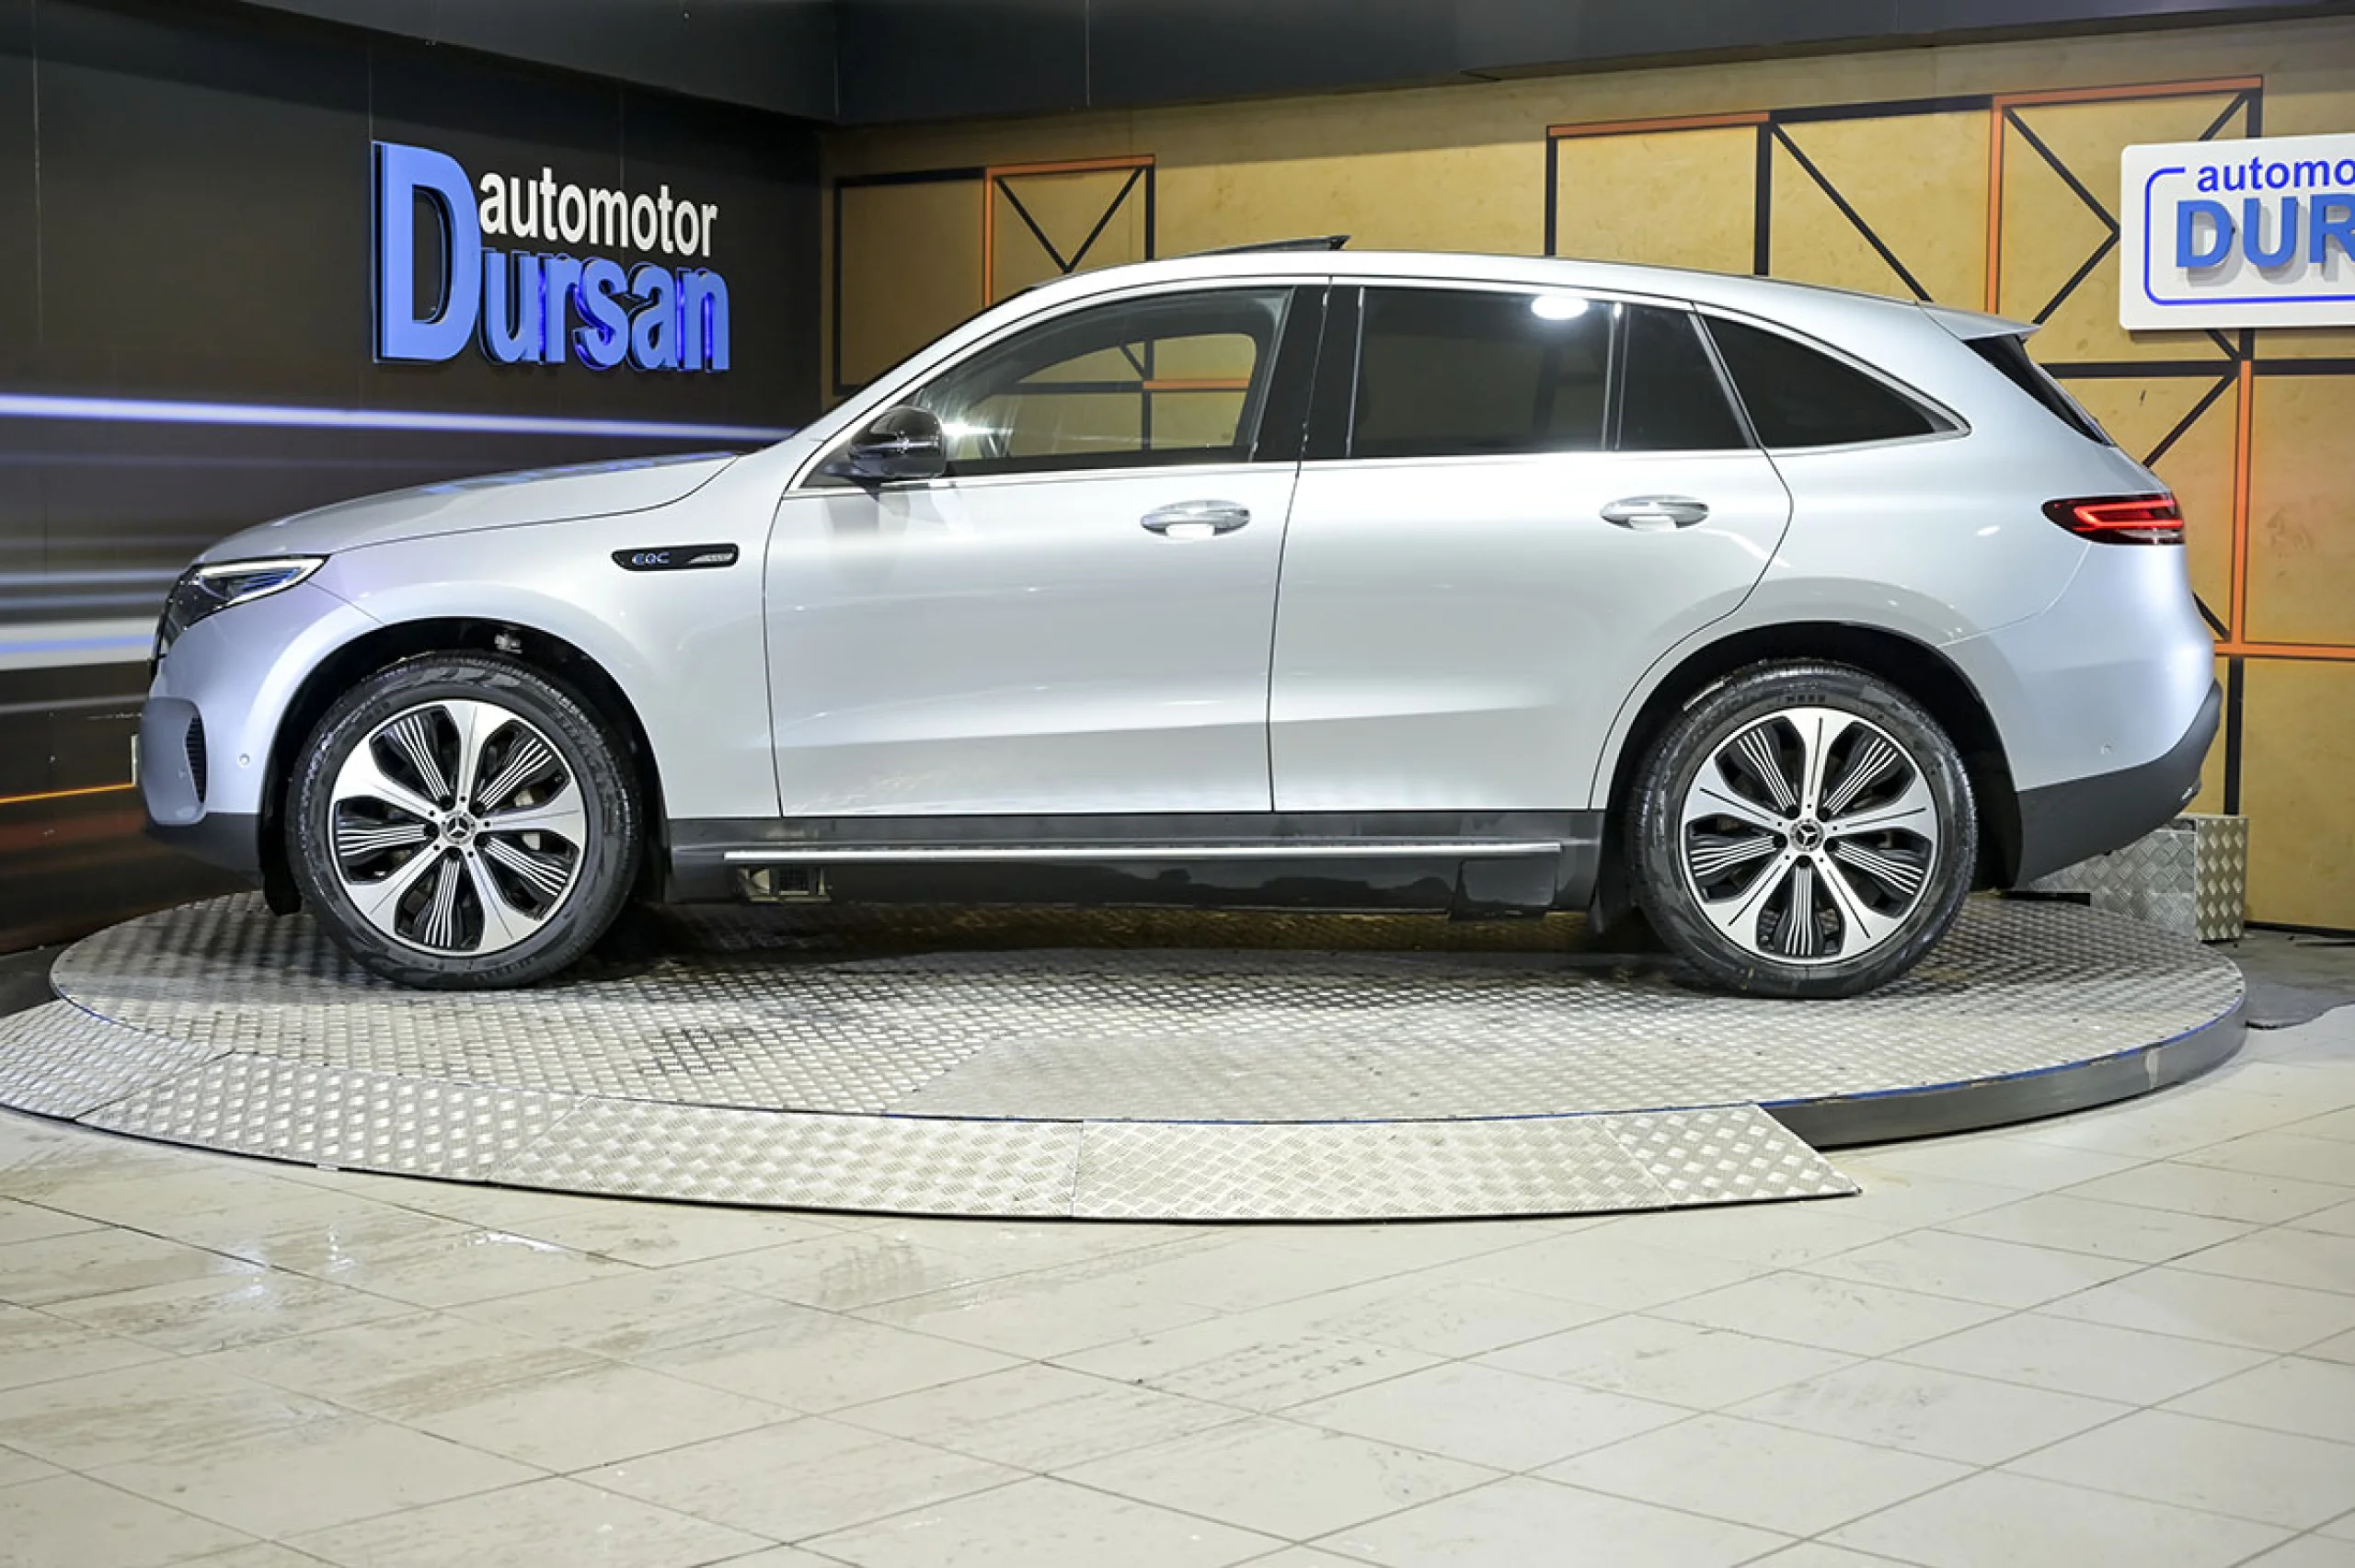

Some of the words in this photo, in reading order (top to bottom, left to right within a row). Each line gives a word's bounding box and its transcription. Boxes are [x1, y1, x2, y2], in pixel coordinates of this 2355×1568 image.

[372, 140, 729, 372] Dursan
[479, 166, 718, 258] automotor
[2176, 193, 2355, 268] DUR
